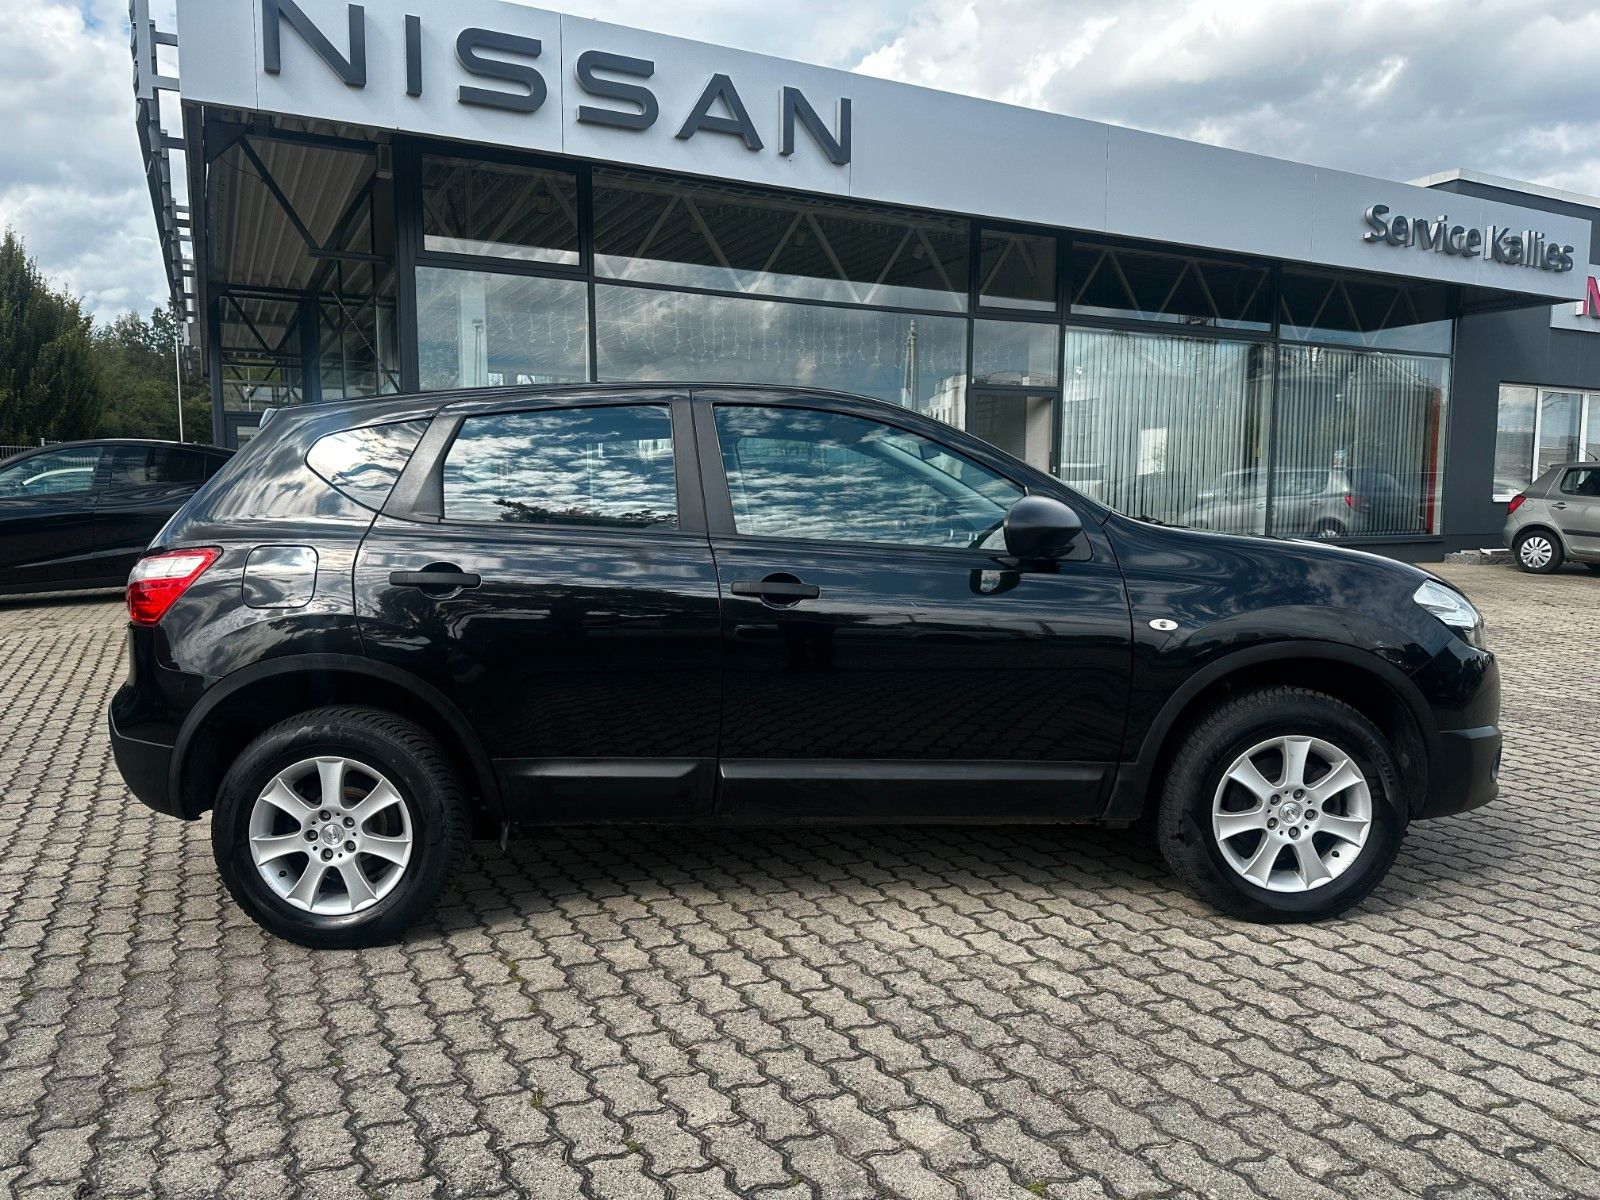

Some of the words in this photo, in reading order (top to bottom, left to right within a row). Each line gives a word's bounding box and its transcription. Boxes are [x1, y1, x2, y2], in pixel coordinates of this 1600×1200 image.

[264, 0, 851, 165] NISSAN
[1363, 205, 1481, 257] Service
[1484, 225, 1574, 272] Kallies
